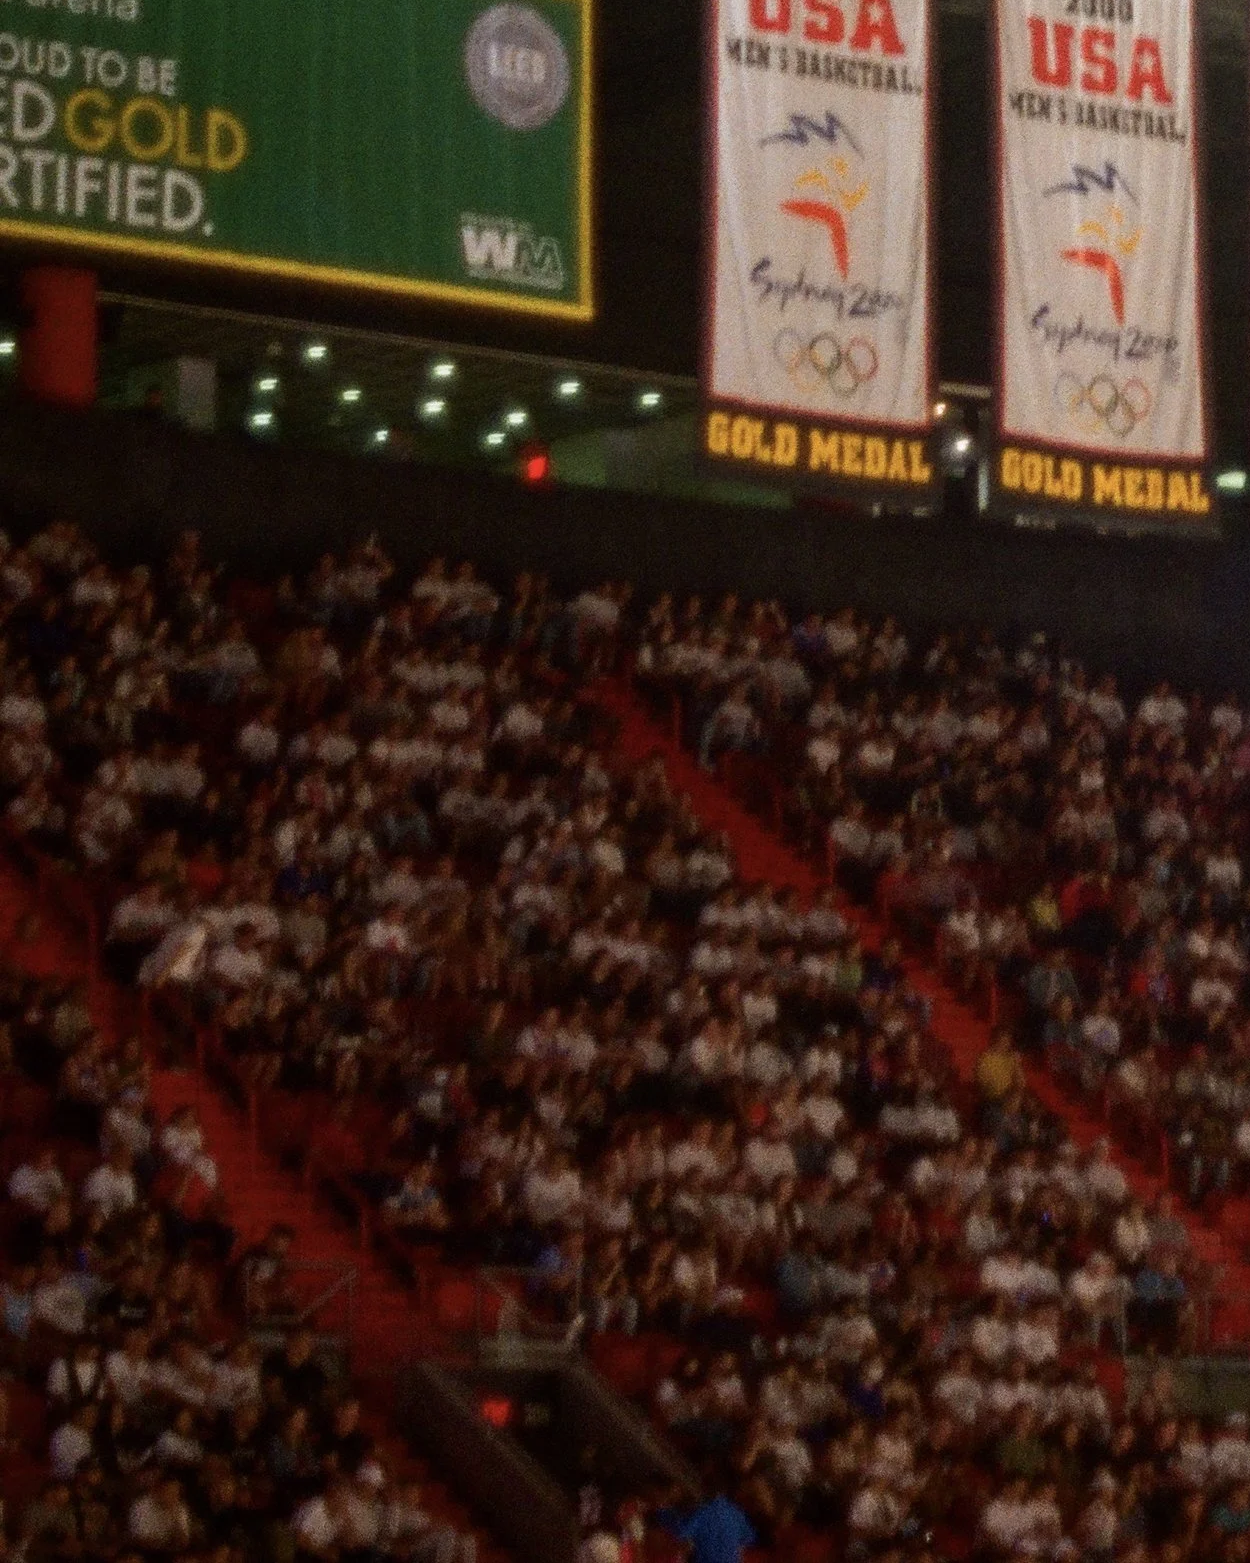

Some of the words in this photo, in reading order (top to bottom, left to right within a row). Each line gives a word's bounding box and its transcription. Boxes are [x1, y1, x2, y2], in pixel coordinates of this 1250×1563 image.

[80, 45, 128, 88] TO
[137, 55, 180, 98] BE
[1027, 15, 1175, 108] USA
[63, 88, 248, 173] GOLD
[707, 410, 799, 467] GOLD
[809, 428, 932, 483] MEDAL
[1001, 446, 1083, 501] GOLD
[1091, 462, 1211, 515] MEDAL
